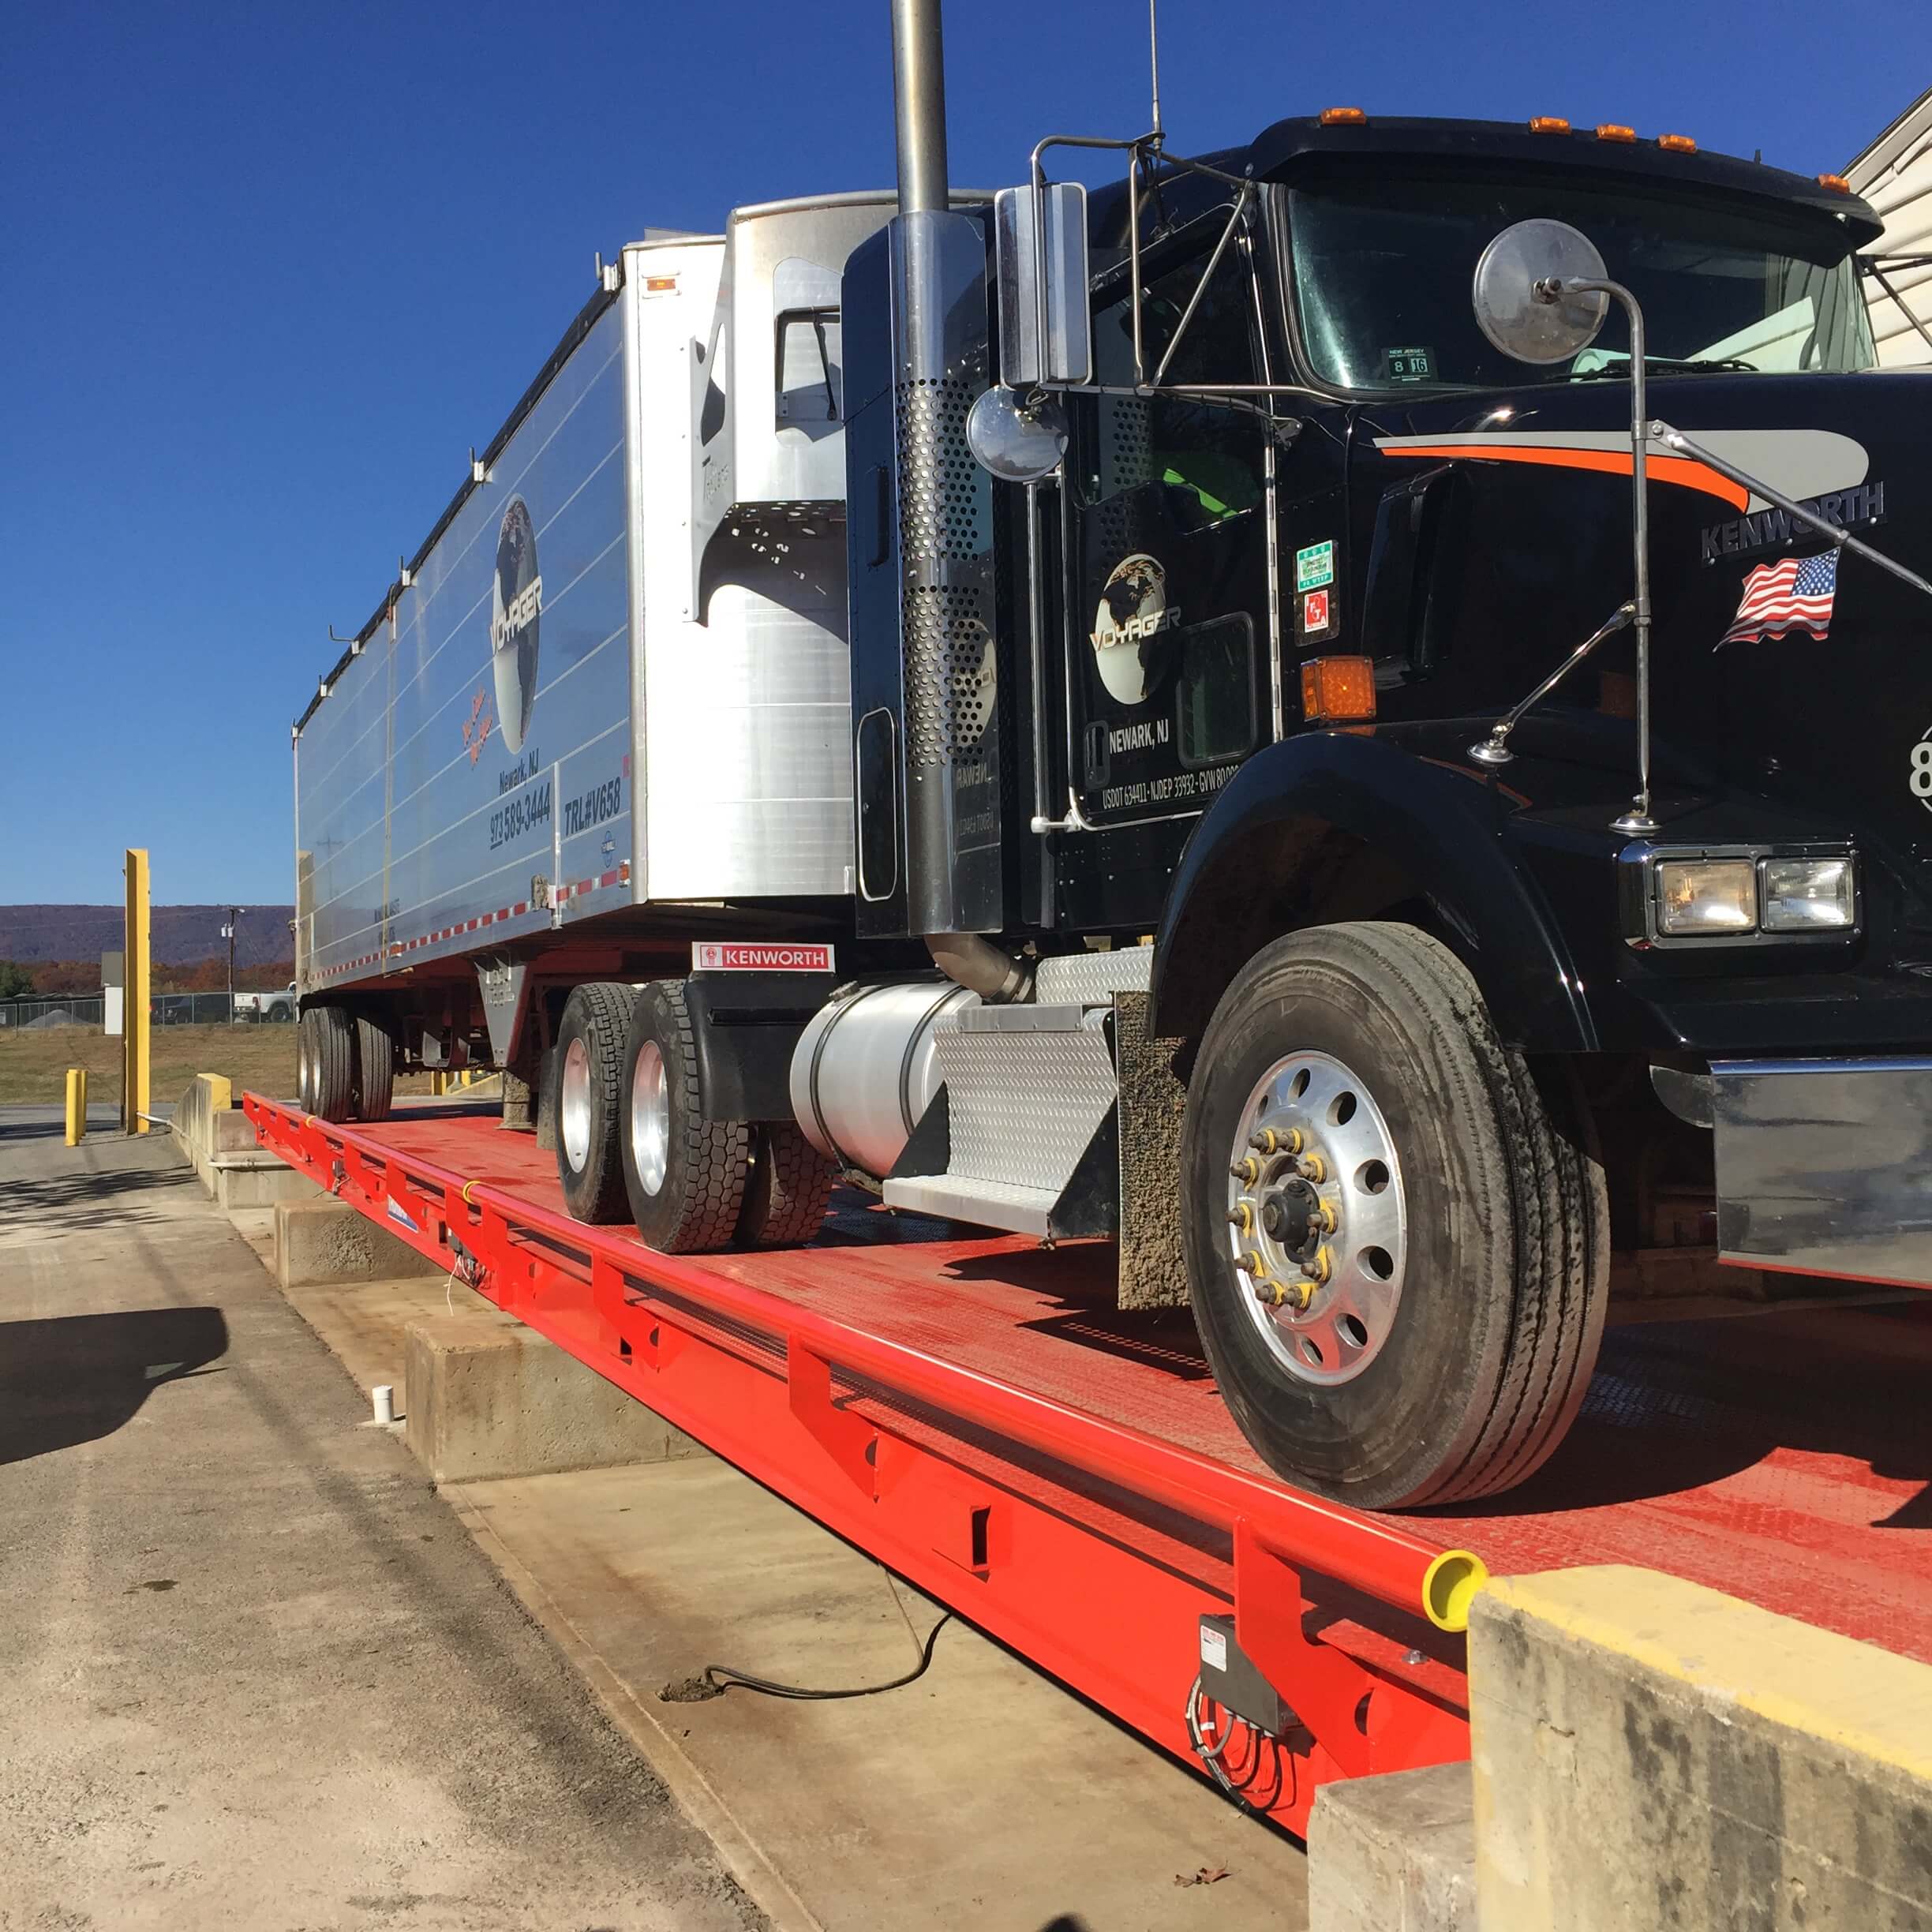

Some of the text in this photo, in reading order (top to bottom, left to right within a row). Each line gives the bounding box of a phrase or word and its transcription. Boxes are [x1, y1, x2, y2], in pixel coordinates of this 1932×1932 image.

[1395, 359, 1426, 373] 8 16
[1701, 481, 1884, 560] KENWORTH
[489, 575, 543, 657] VOYAGER
[1089, 605, 1181, 652] VOYAGER
[1109, 718, 1169, 754] NEWARK, NJ
[499, 747, 539, 796] Newark, NJ
[1103, 787, 1124, 810] USDOT
[1124, 782, 1148, 807] 634411
[1150, 777, 1173, 801] NJDEP
[1174, 773, 1195, 798] 33932
[1199, 769, 1216, 792] GVW
[490, 782, 550, 844] 973 589-3444
[565, 776, 621, 837] TRL#V658
[726, 950, 824, 965] KENWORTH
